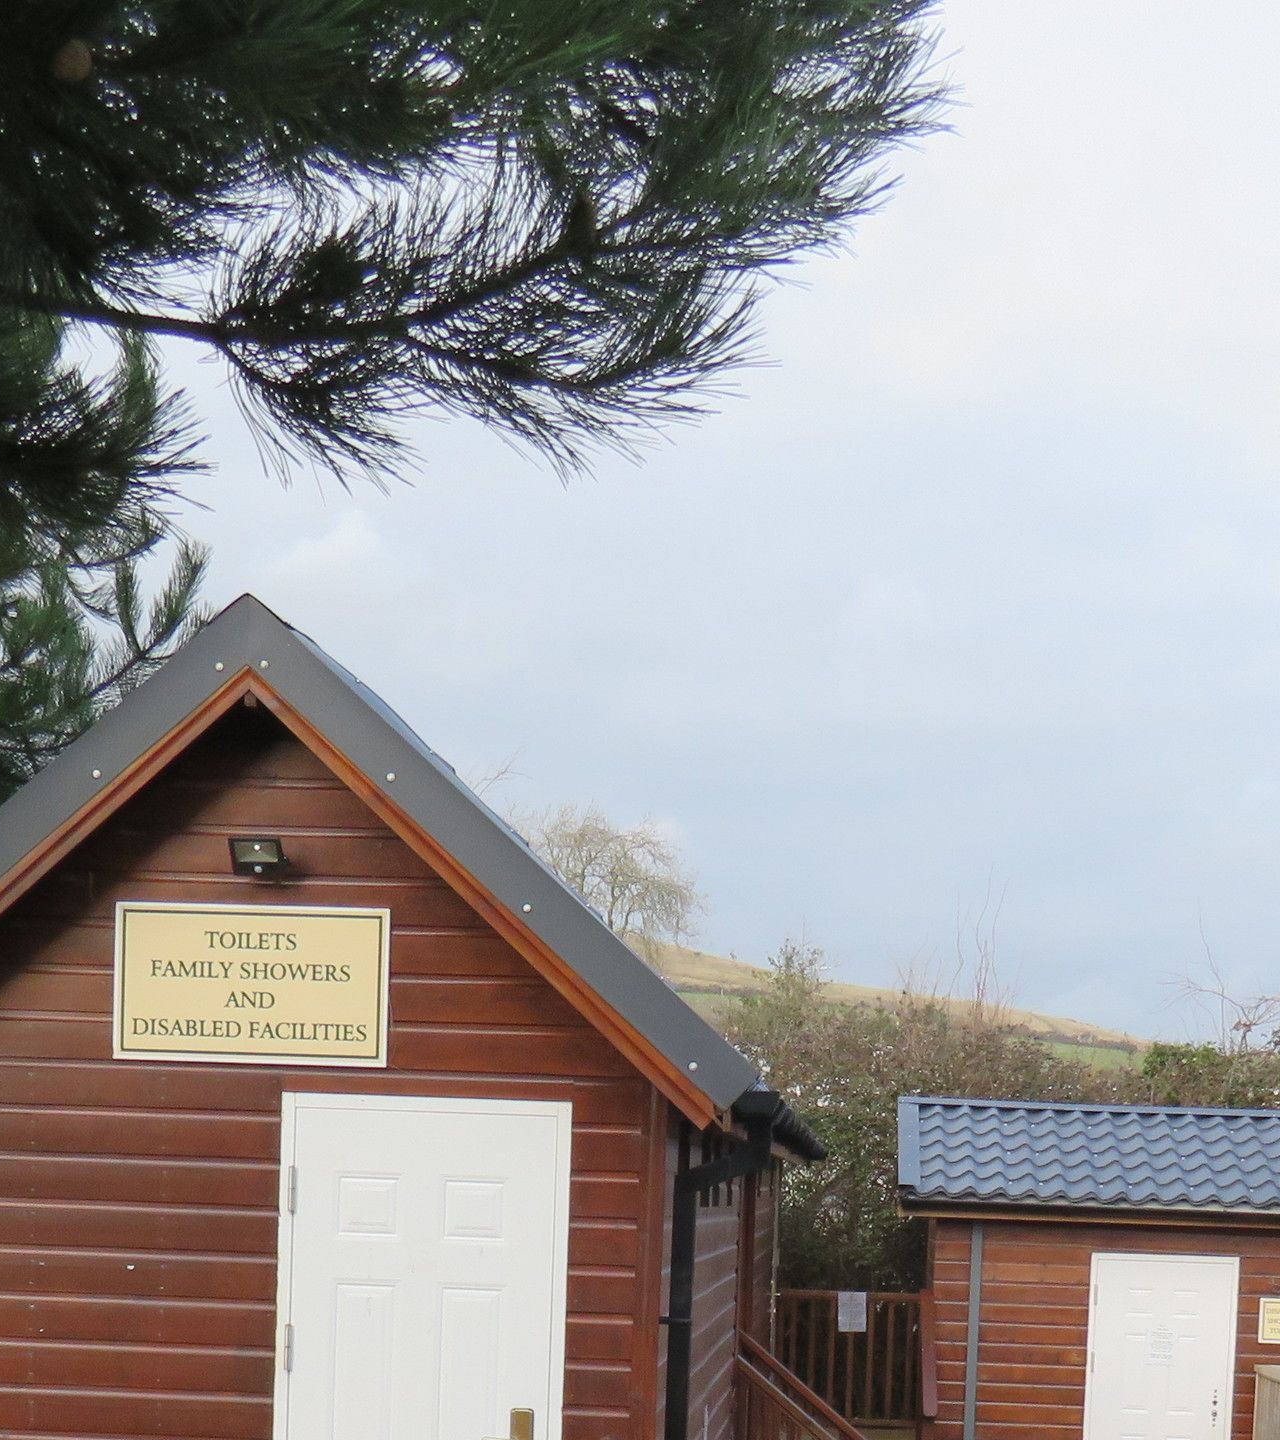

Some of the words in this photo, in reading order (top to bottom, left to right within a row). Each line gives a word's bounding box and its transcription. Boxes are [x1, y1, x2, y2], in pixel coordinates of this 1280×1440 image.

[204, 930, 297, 951] TOILETS
[150, 959, 234, 979] FAMILY
[239, 962, 351, 983] SHOWERS
[223, 991, 276, 1010] AND
[131, 1017, 242, 1039] DISABLED
[248, 1022, 368, 1043] FACILITIES
